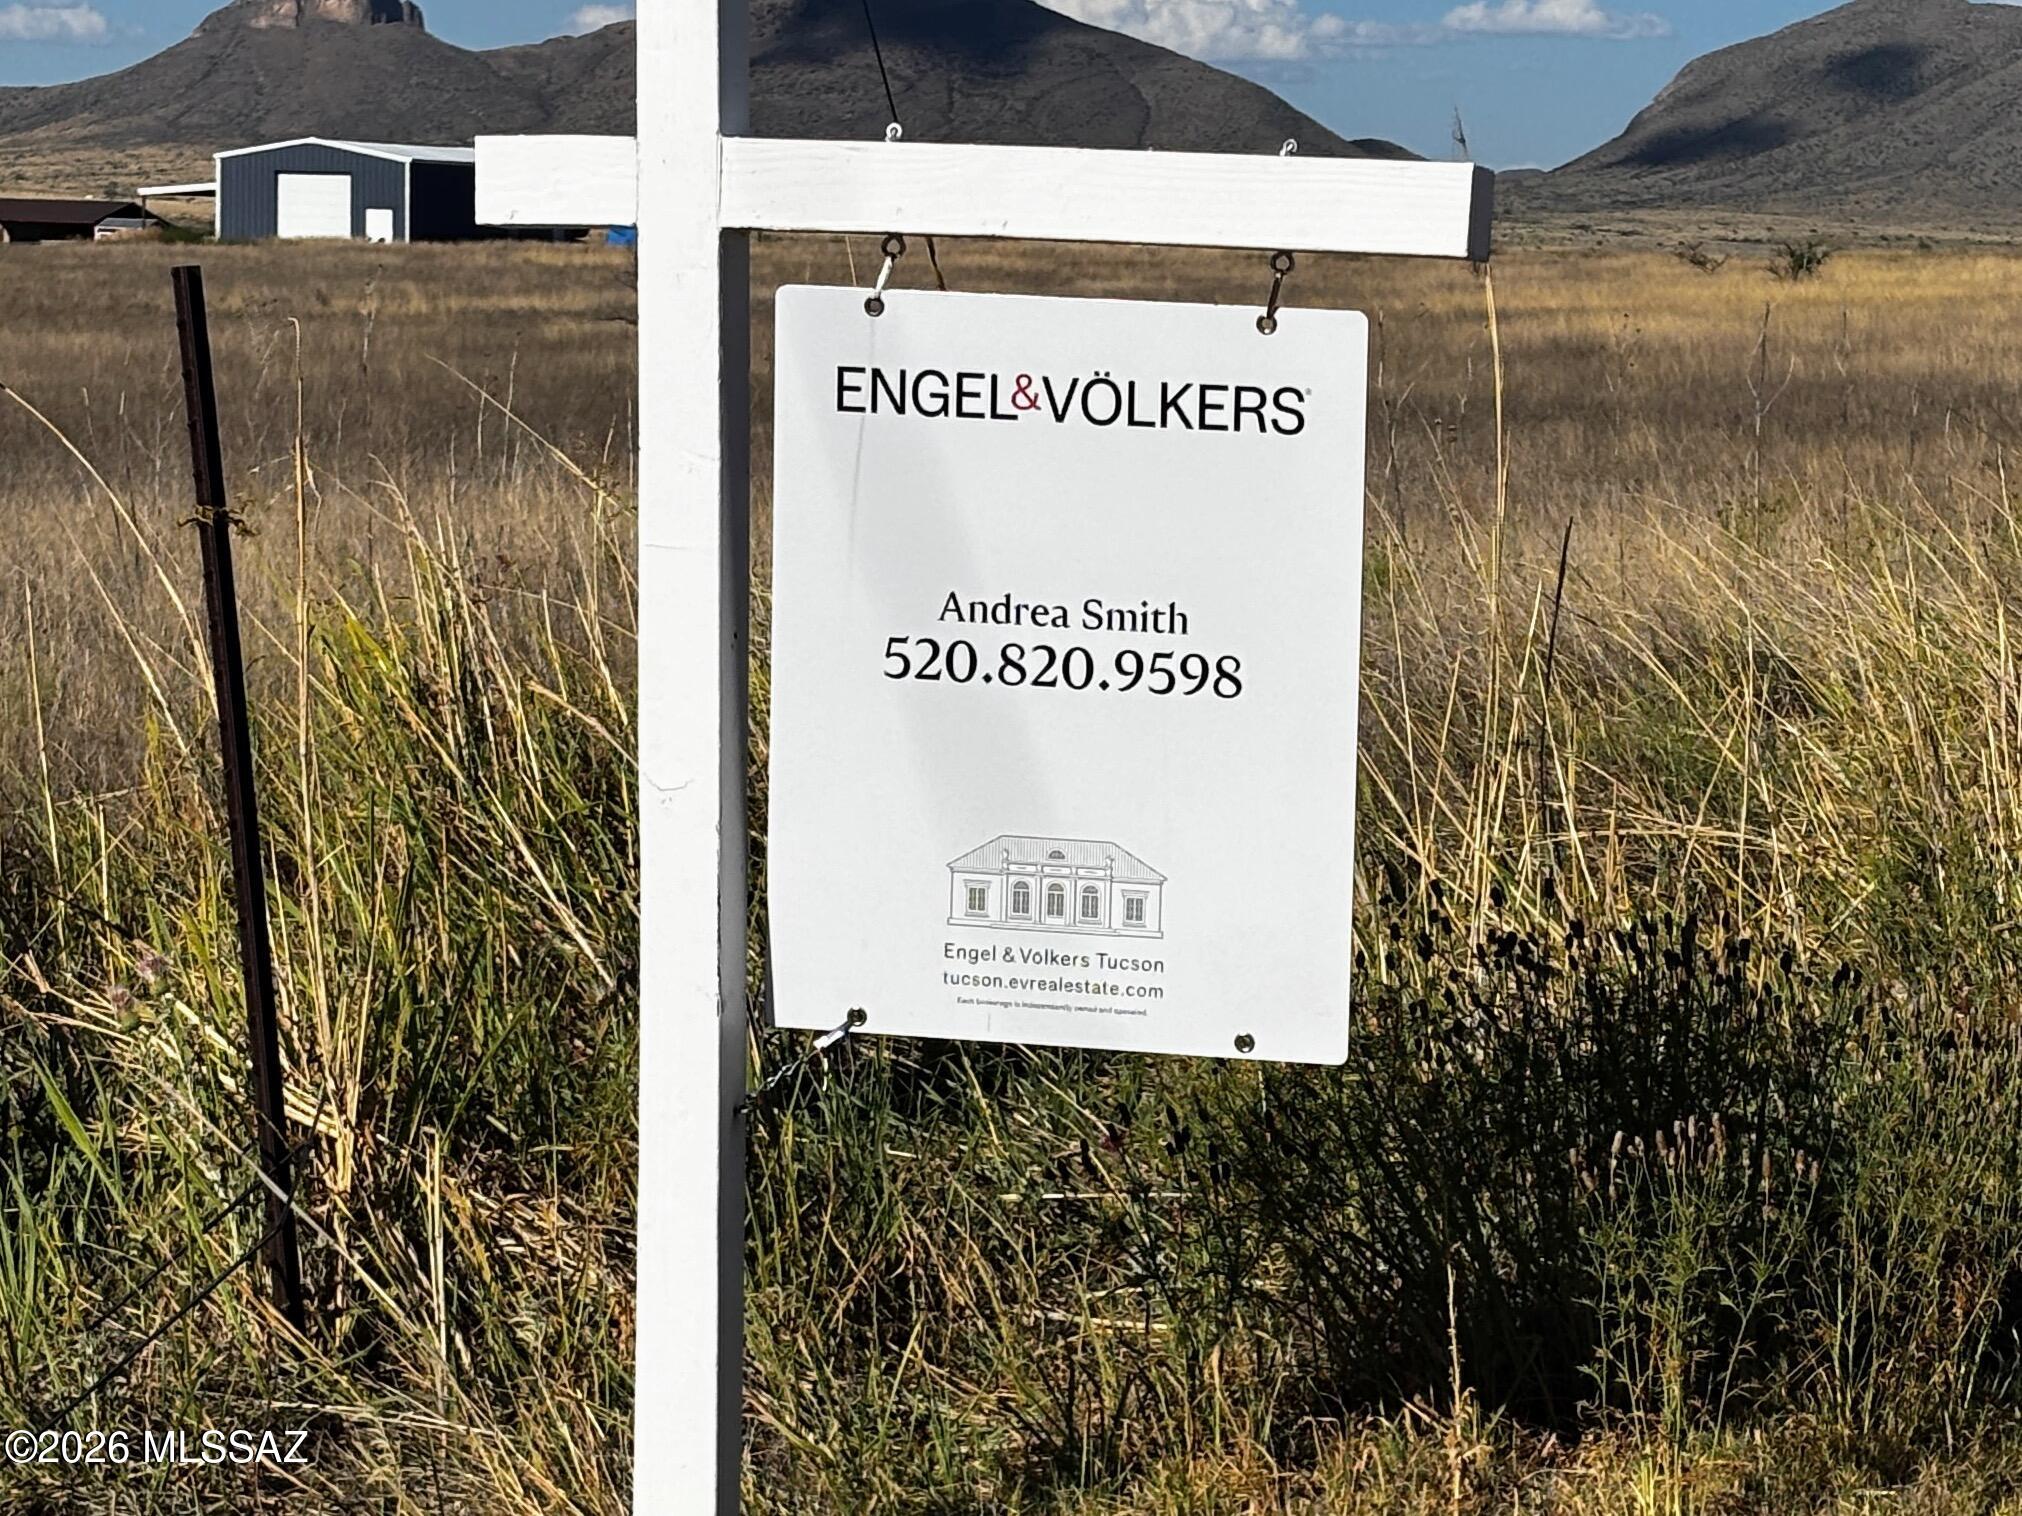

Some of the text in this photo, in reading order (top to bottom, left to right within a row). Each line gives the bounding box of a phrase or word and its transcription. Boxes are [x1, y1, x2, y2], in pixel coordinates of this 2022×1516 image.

[938, 591, 1189, 635] Andrea Smith
[884, 635, 1243, 699] 520.820.9598
[944, 942, 997, 965] Engel
[1002, 946, 1016, 963] &
[1095, 952, 1164, 973] Tucson
[943, 971, 1164, 999] tucson.evrealestate.com
